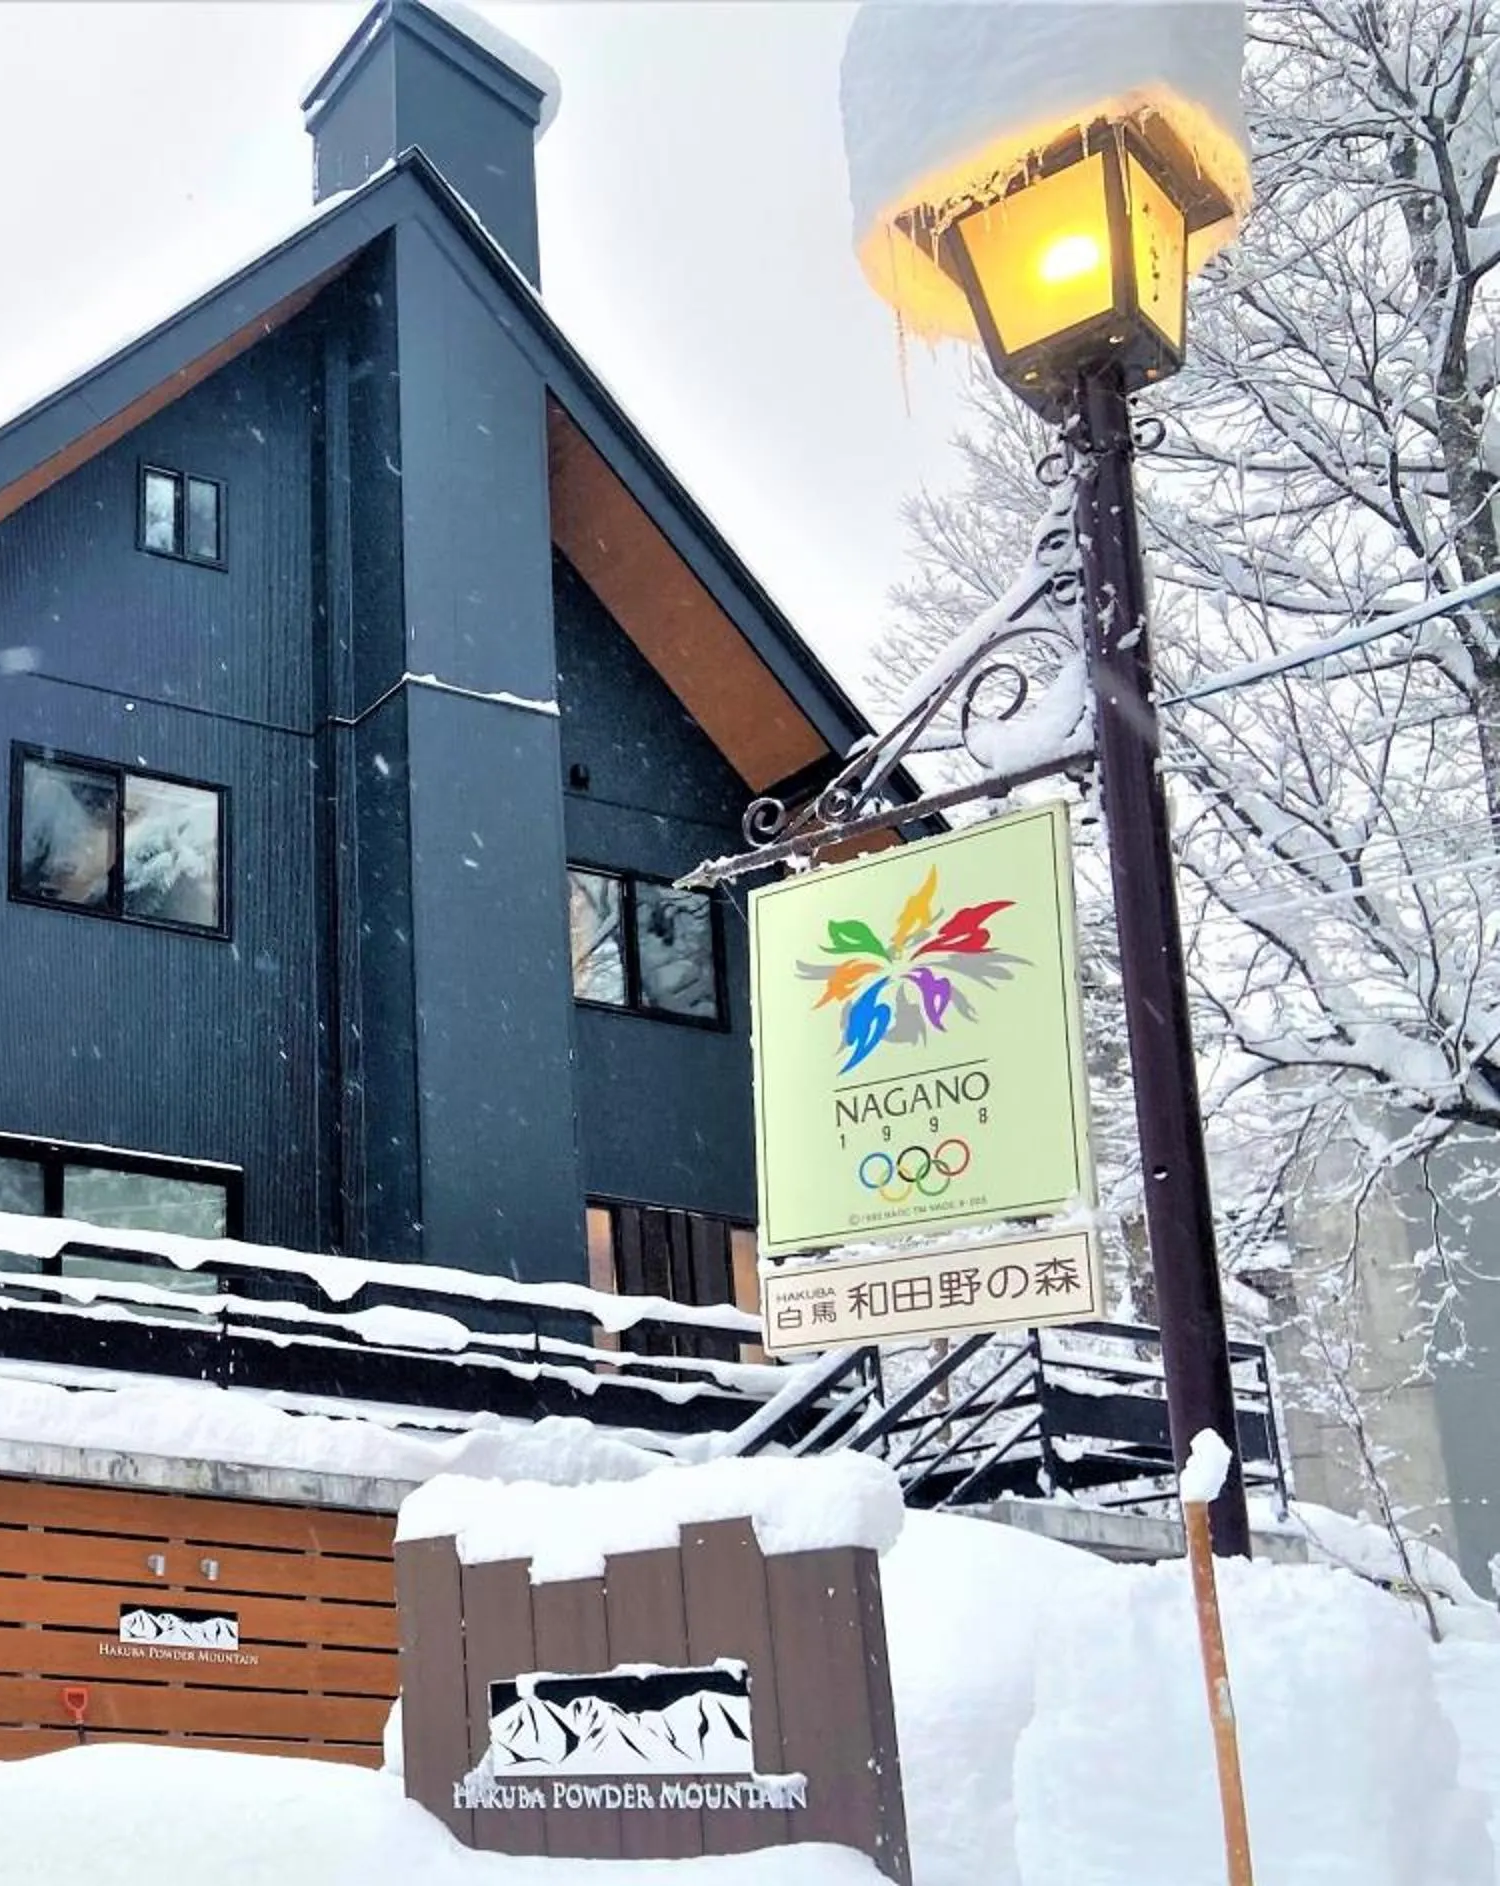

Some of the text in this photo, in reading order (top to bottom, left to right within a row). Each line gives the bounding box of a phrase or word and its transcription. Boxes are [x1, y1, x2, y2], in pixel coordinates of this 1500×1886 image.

[835, 1071, 990, 1127] NAGANO
[776, 1287, 837, 1302] HAKUBA
[847, 1257, 1081, 1320] 和田野の森
[452, 1781, 807, 1809] HAKUBA POWDER MOUNTAIN
